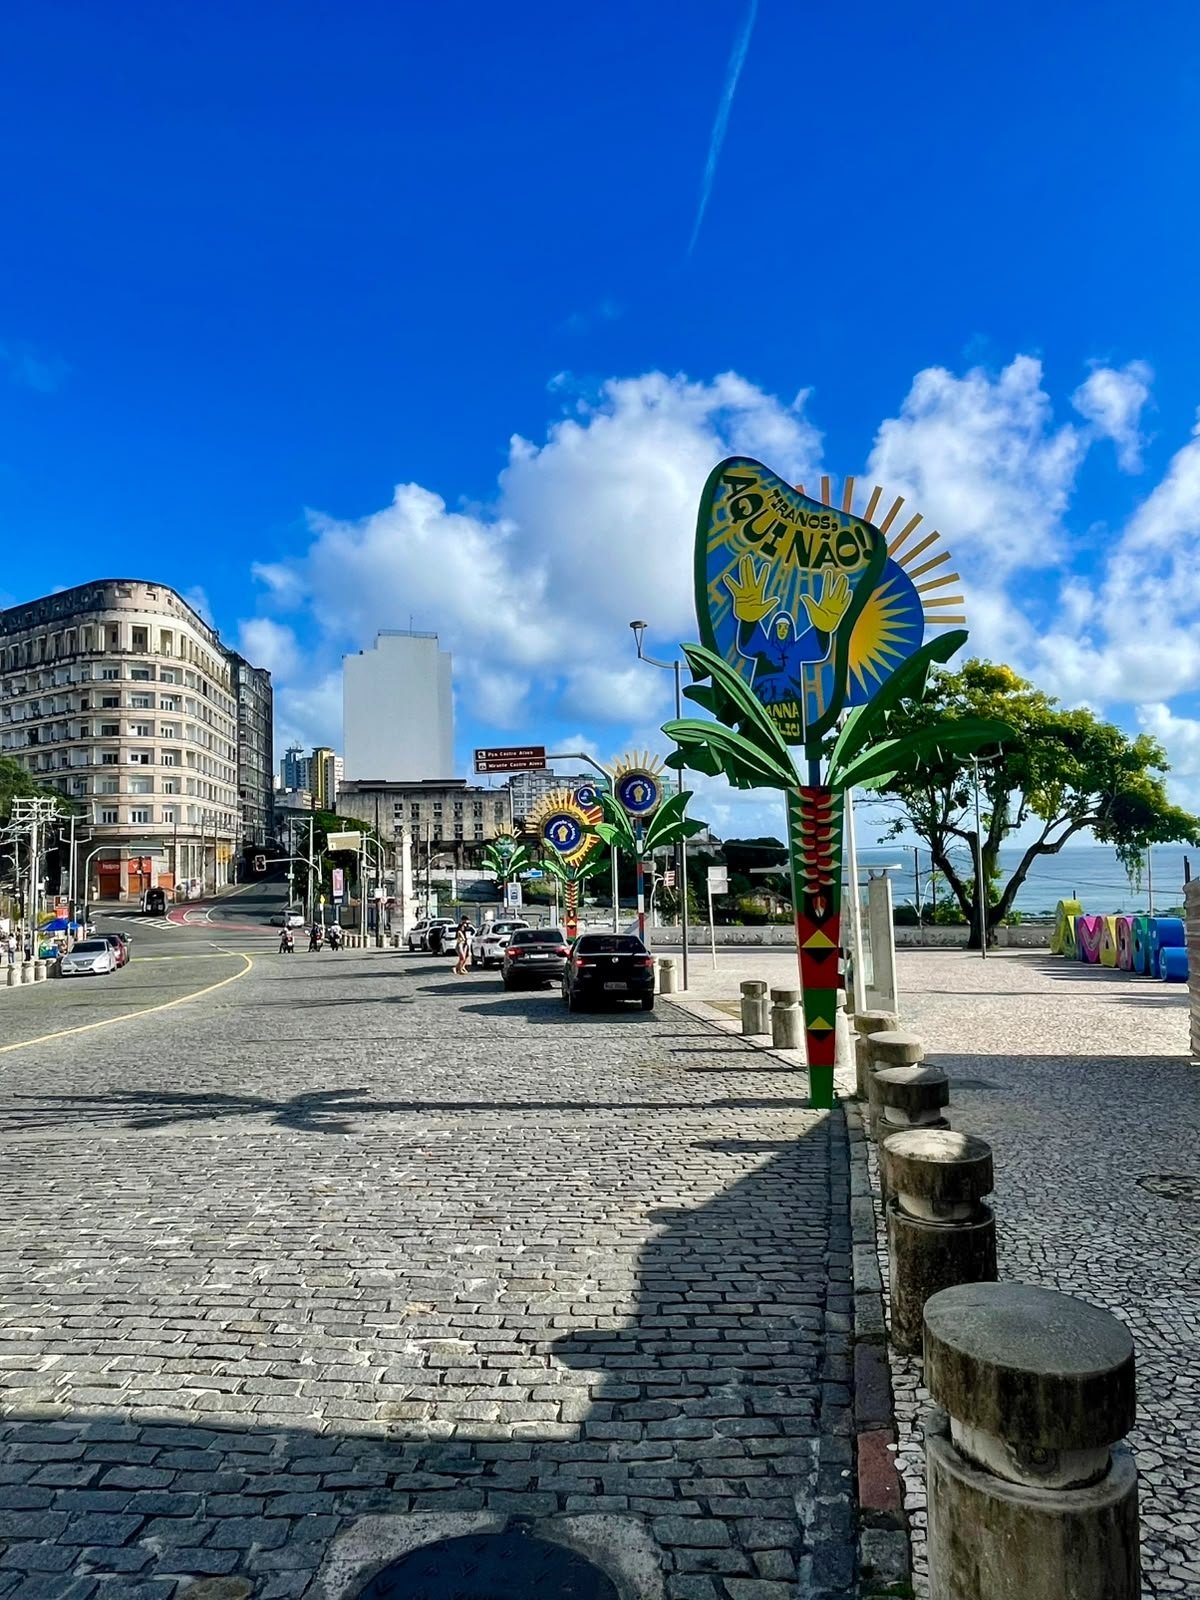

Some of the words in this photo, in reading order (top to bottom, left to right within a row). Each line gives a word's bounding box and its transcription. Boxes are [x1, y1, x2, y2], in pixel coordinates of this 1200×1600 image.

[723, 475, 788, 557] AQUI
[785, 525, 873, 569] NÃO!
[767, 489, 839, 532] TIRANOS,
